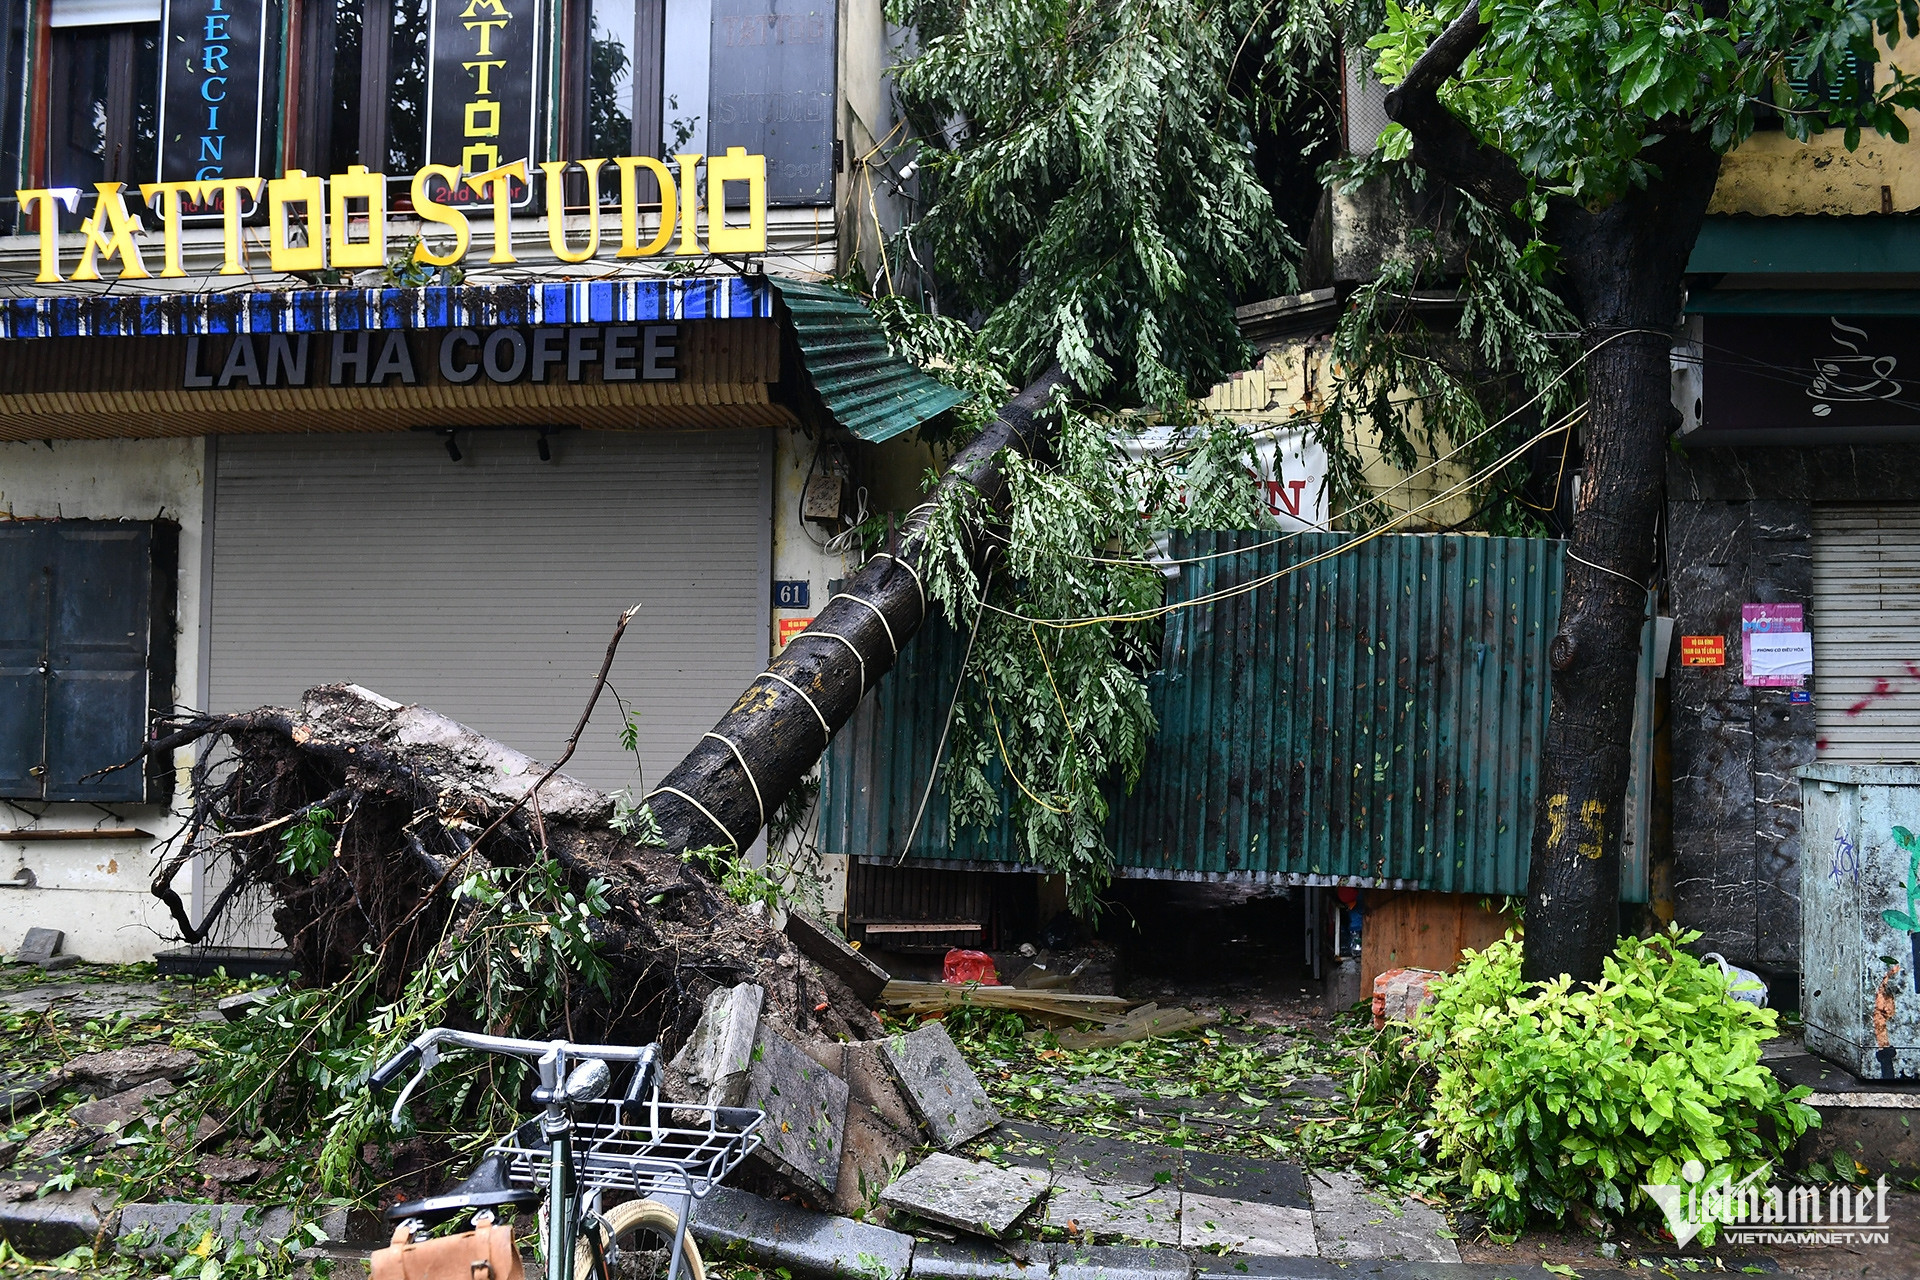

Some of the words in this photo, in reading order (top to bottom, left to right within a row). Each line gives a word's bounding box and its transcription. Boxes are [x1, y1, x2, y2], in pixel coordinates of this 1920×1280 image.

[15, 165, 387, 283] TATTOO
[410, 147, 767, 266] STUDIO
[183, 334, 310, 388] LAN
[329, 332, 416, 387] HA
[439, 325, 679, 384] COFFEE
[780, 585, 800, 603] 61
[1742, 611, 1772, 632] MỞ
